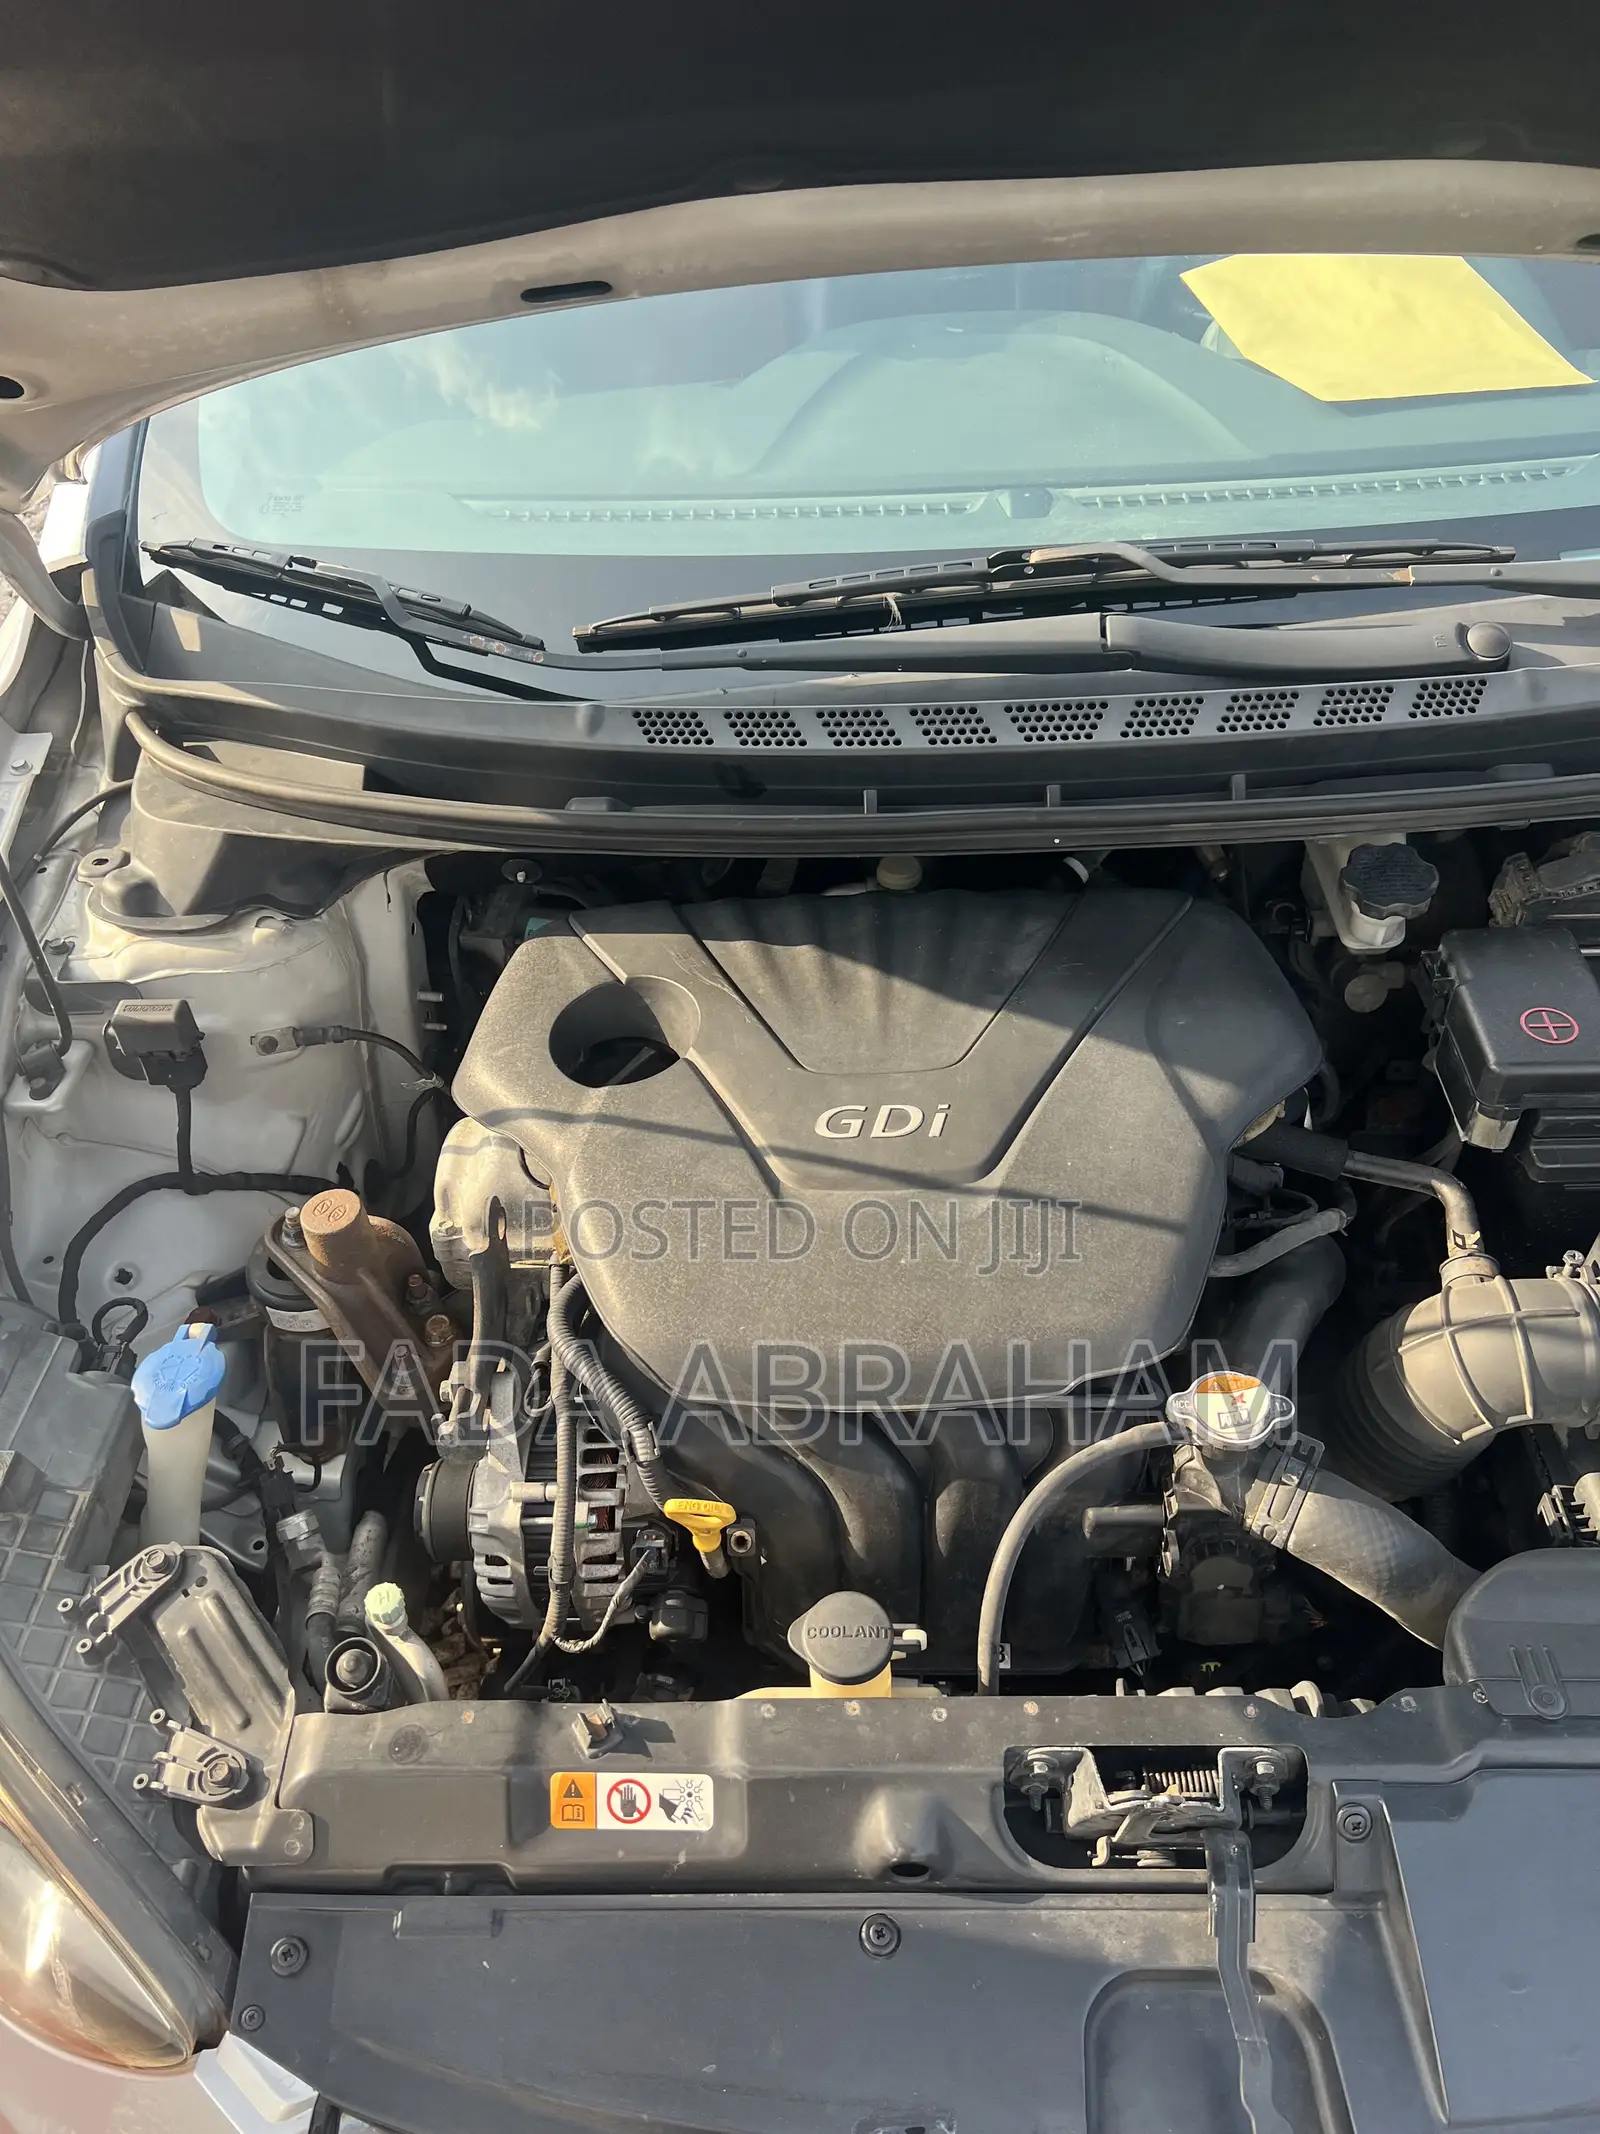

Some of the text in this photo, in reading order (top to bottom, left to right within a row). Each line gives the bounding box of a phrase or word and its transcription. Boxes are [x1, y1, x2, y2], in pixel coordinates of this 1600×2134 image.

[814, 1103, 951, 1139] GDi
[678, 1500, 699, 1510] ENG
[807, 1625, 892, 1640] COOLANT
